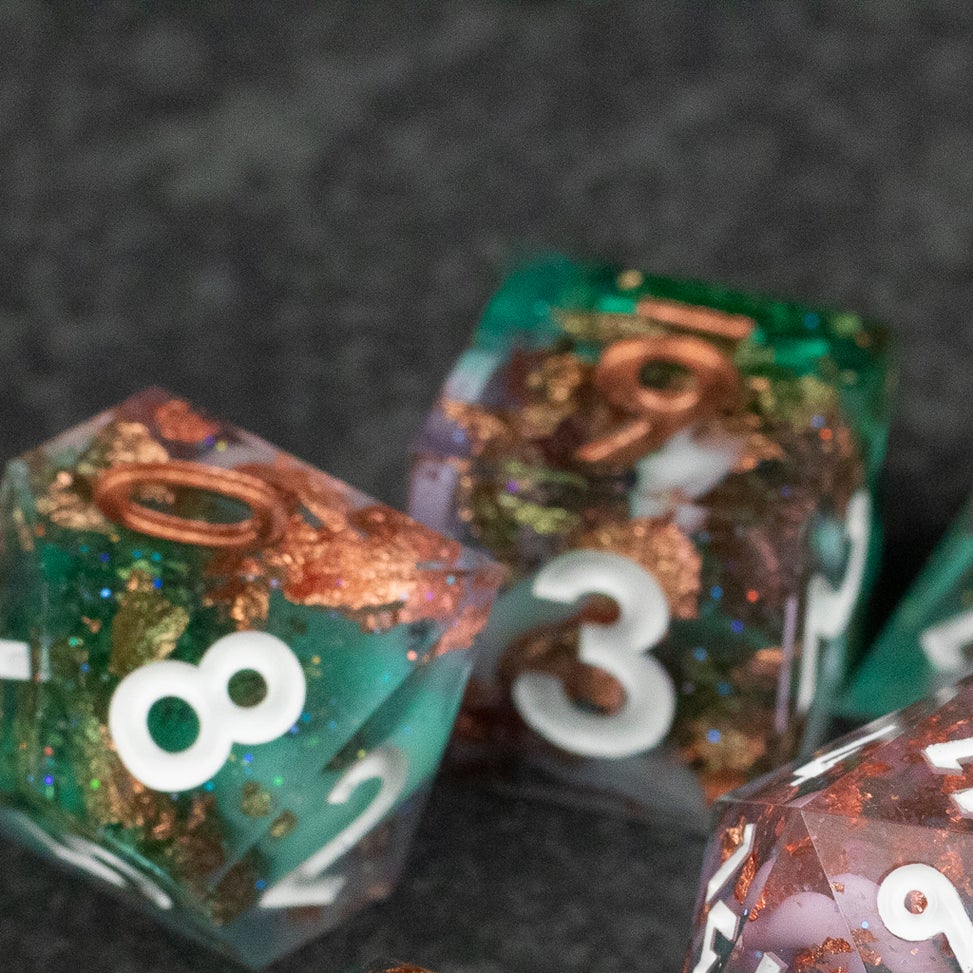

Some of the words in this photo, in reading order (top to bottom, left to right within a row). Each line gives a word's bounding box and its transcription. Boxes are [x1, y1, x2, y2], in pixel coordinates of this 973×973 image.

[93, 463, 290, 547] 0
[109, 630, 306, 792] 8
[512, 549, 677, 760] 3
[258, 744, 410, 909] 2
